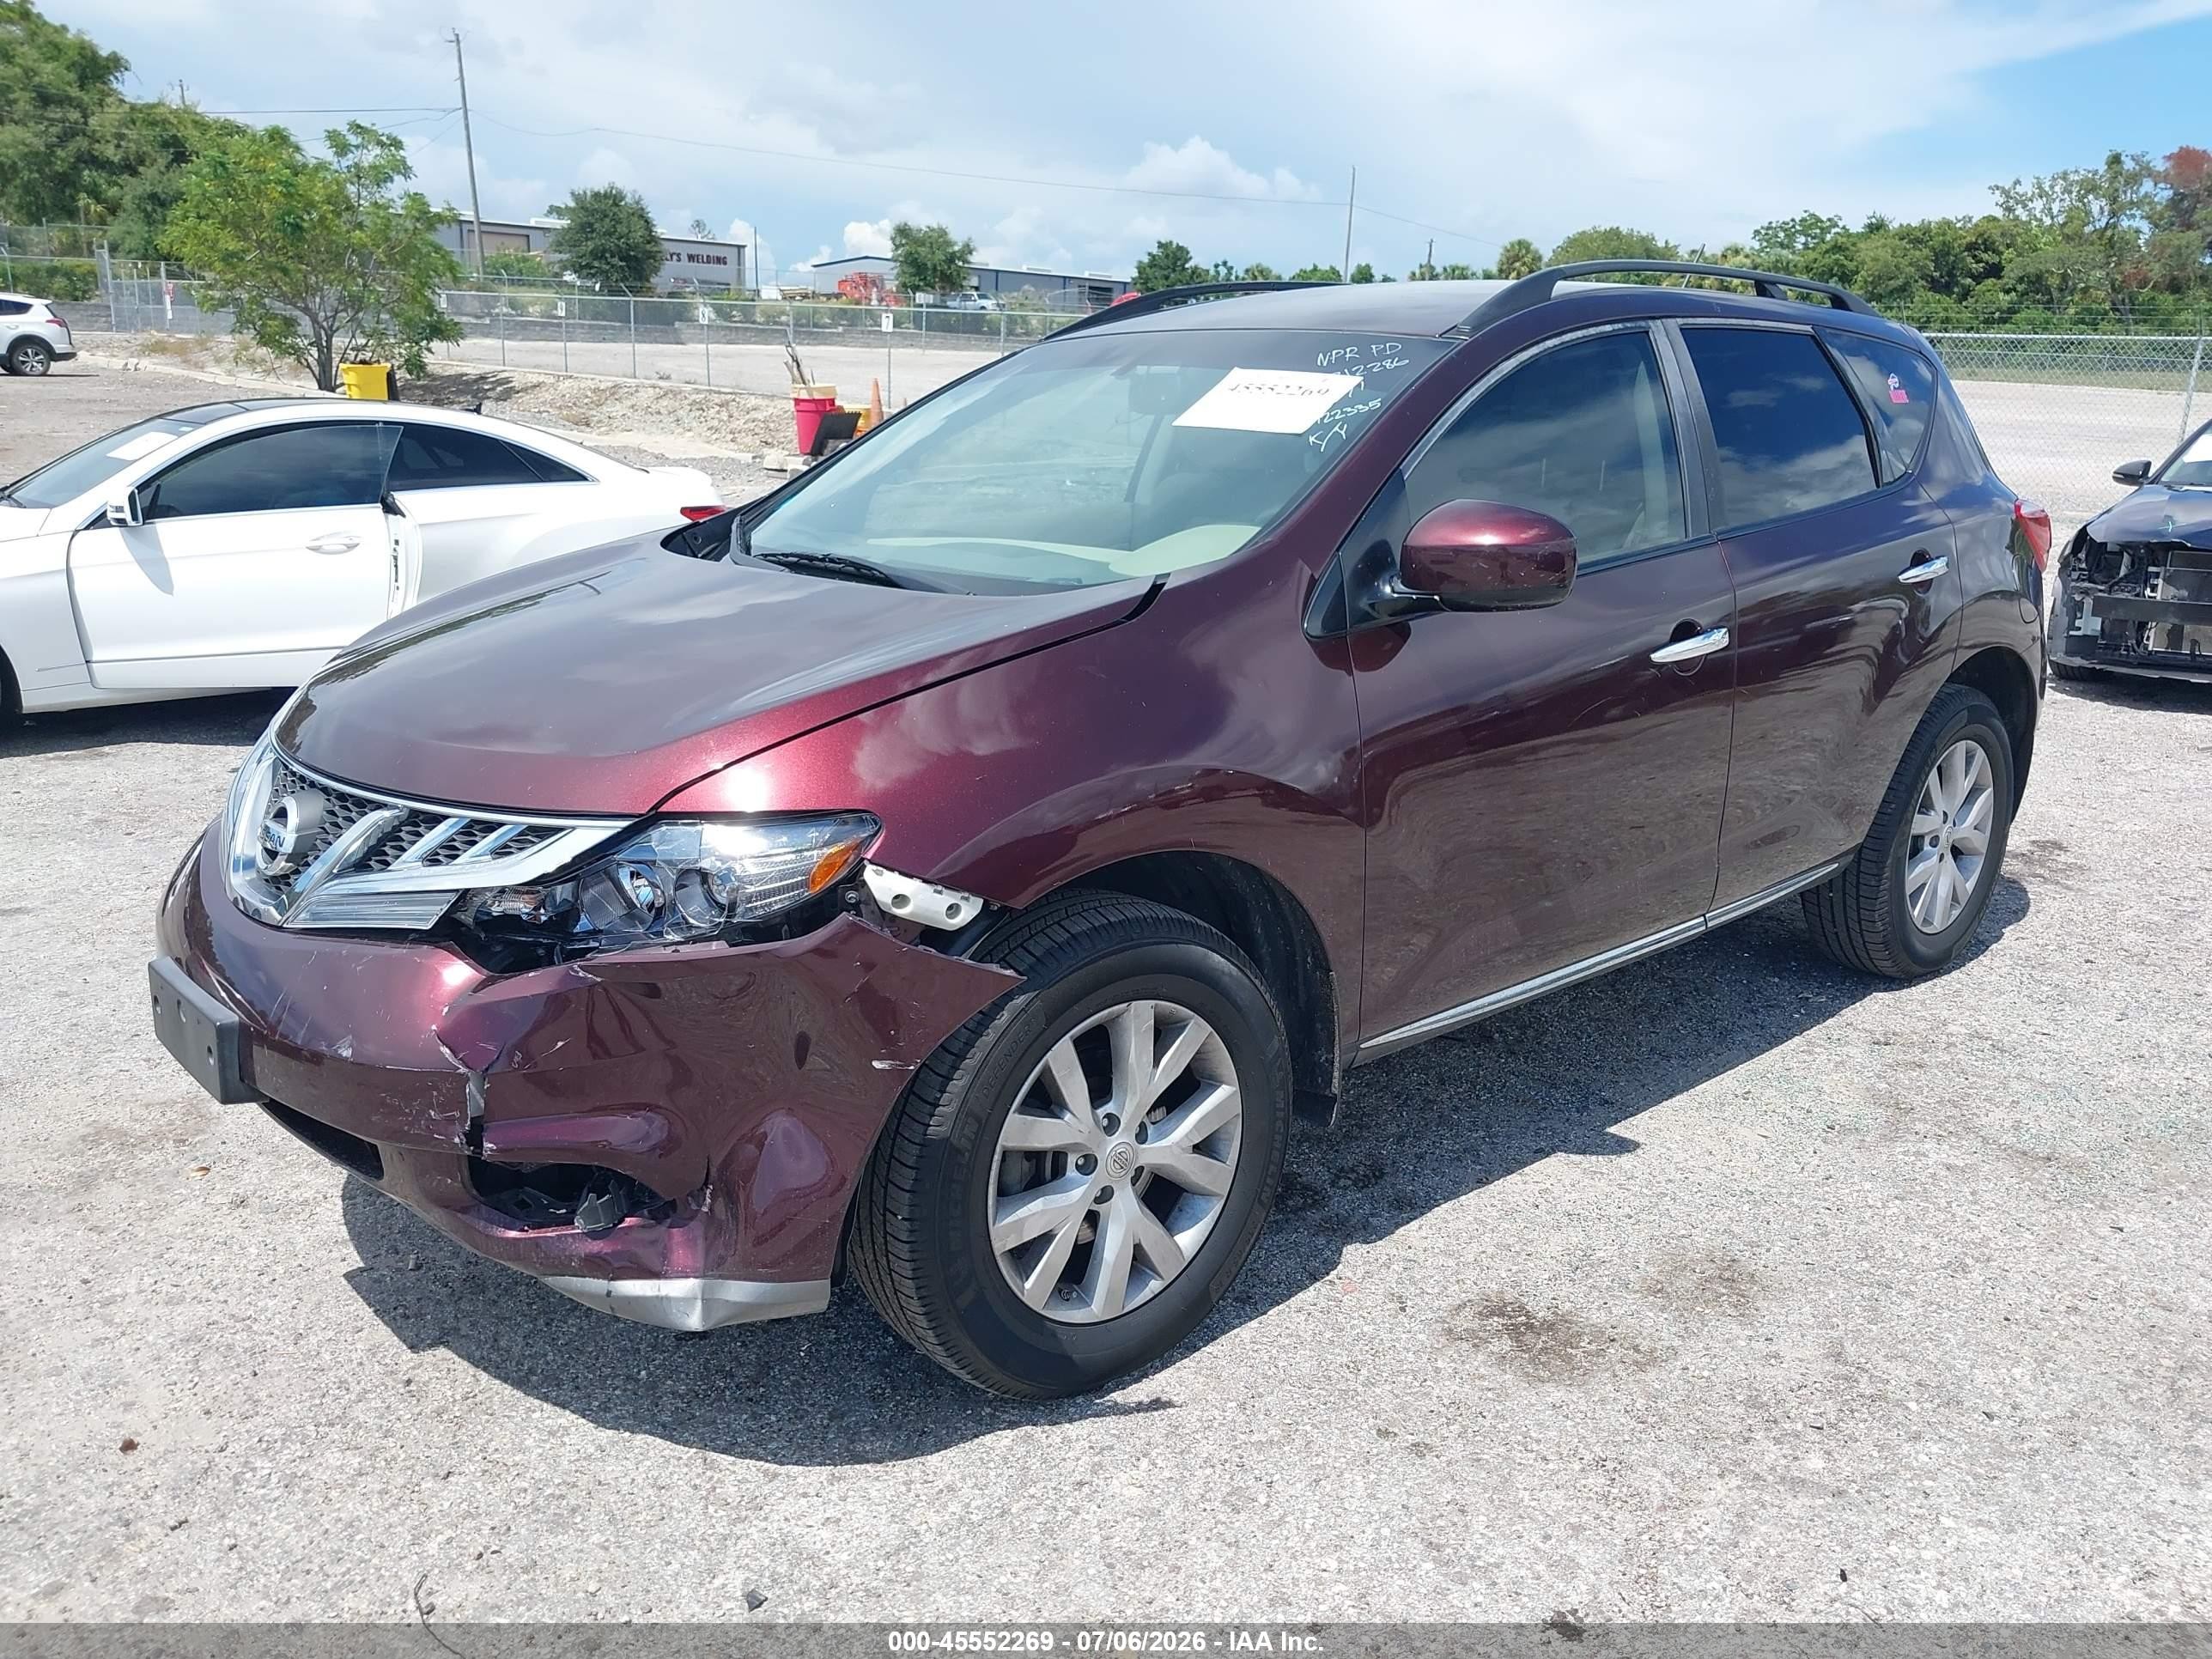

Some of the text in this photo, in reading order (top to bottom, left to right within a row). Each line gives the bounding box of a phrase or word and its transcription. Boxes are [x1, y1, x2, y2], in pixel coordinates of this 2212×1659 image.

[687, 253, 728, 266] WELDING
[884, 315, 891, 330] 7
[1370, 343, 1402, 356] PD
